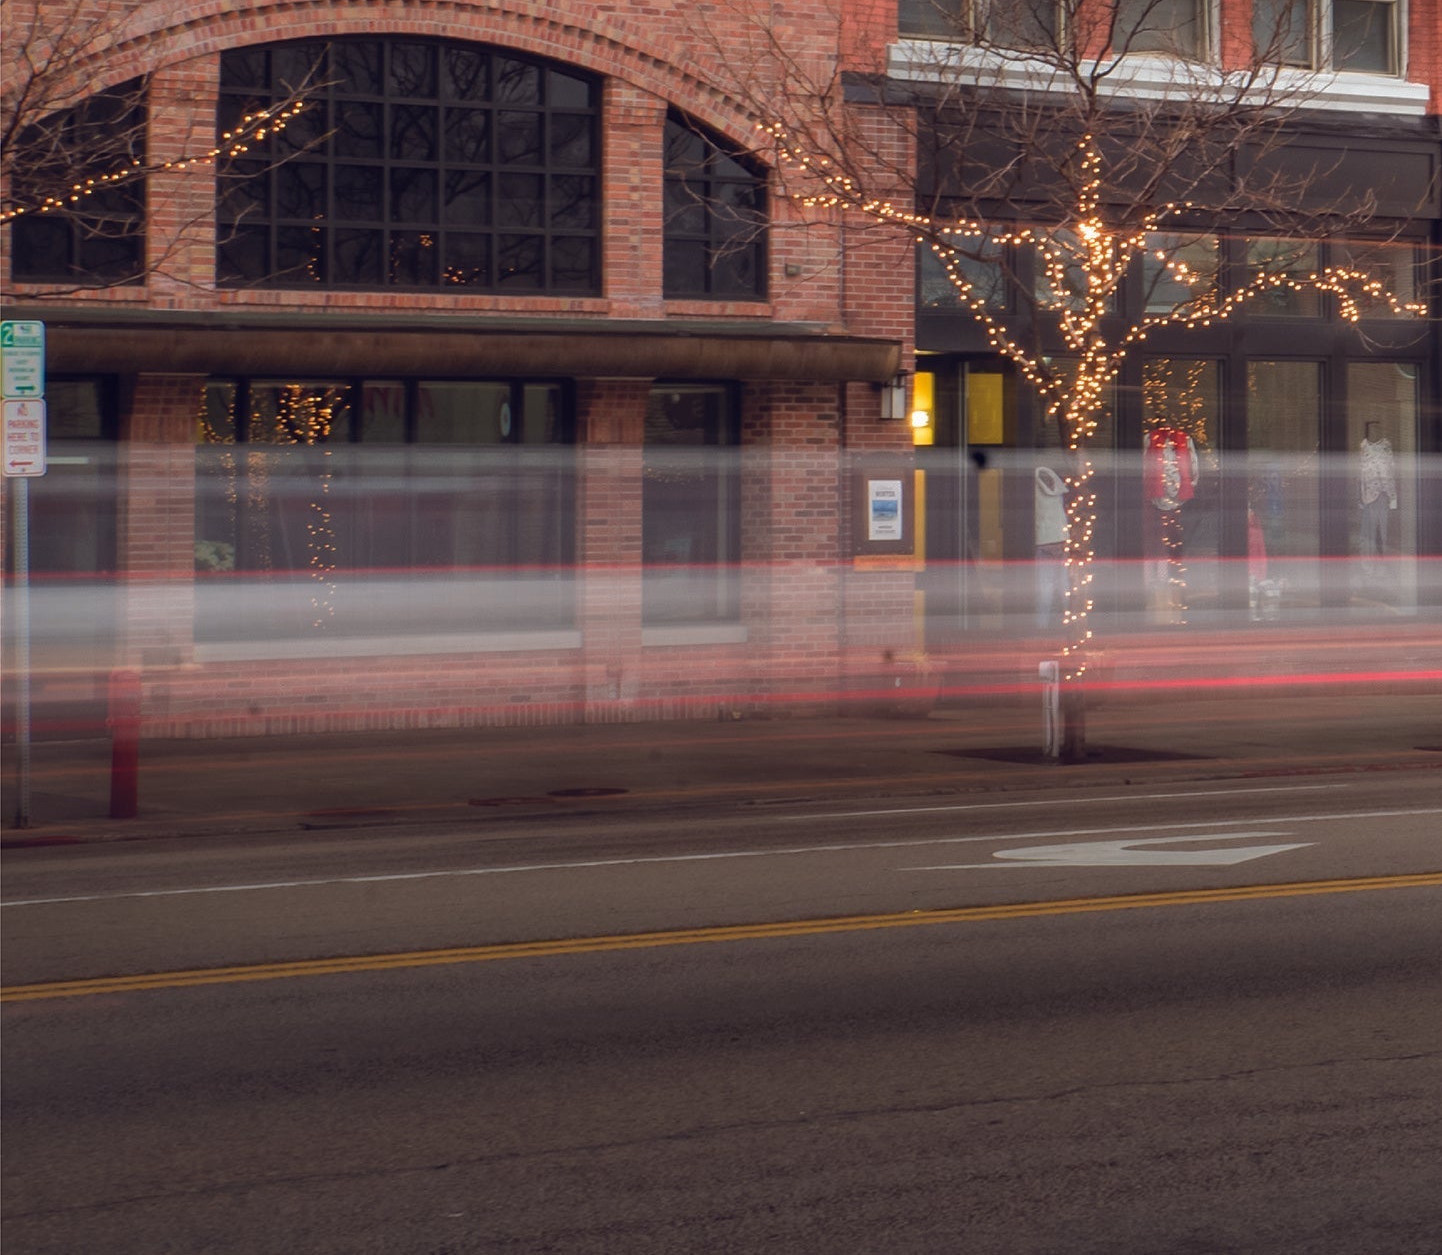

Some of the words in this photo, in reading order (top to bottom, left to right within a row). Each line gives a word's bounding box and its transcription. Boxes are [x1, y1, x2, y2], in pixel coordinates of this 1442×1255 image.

[3, 326, 13, 345] 2
[17, 407, 28, 417] NO
[8, 419, 39, 429] PARKING
[8, 432, 27, 442] HERE
[31, 432, 39, 442] TO
[9, 445, 39, 455] CORNER
